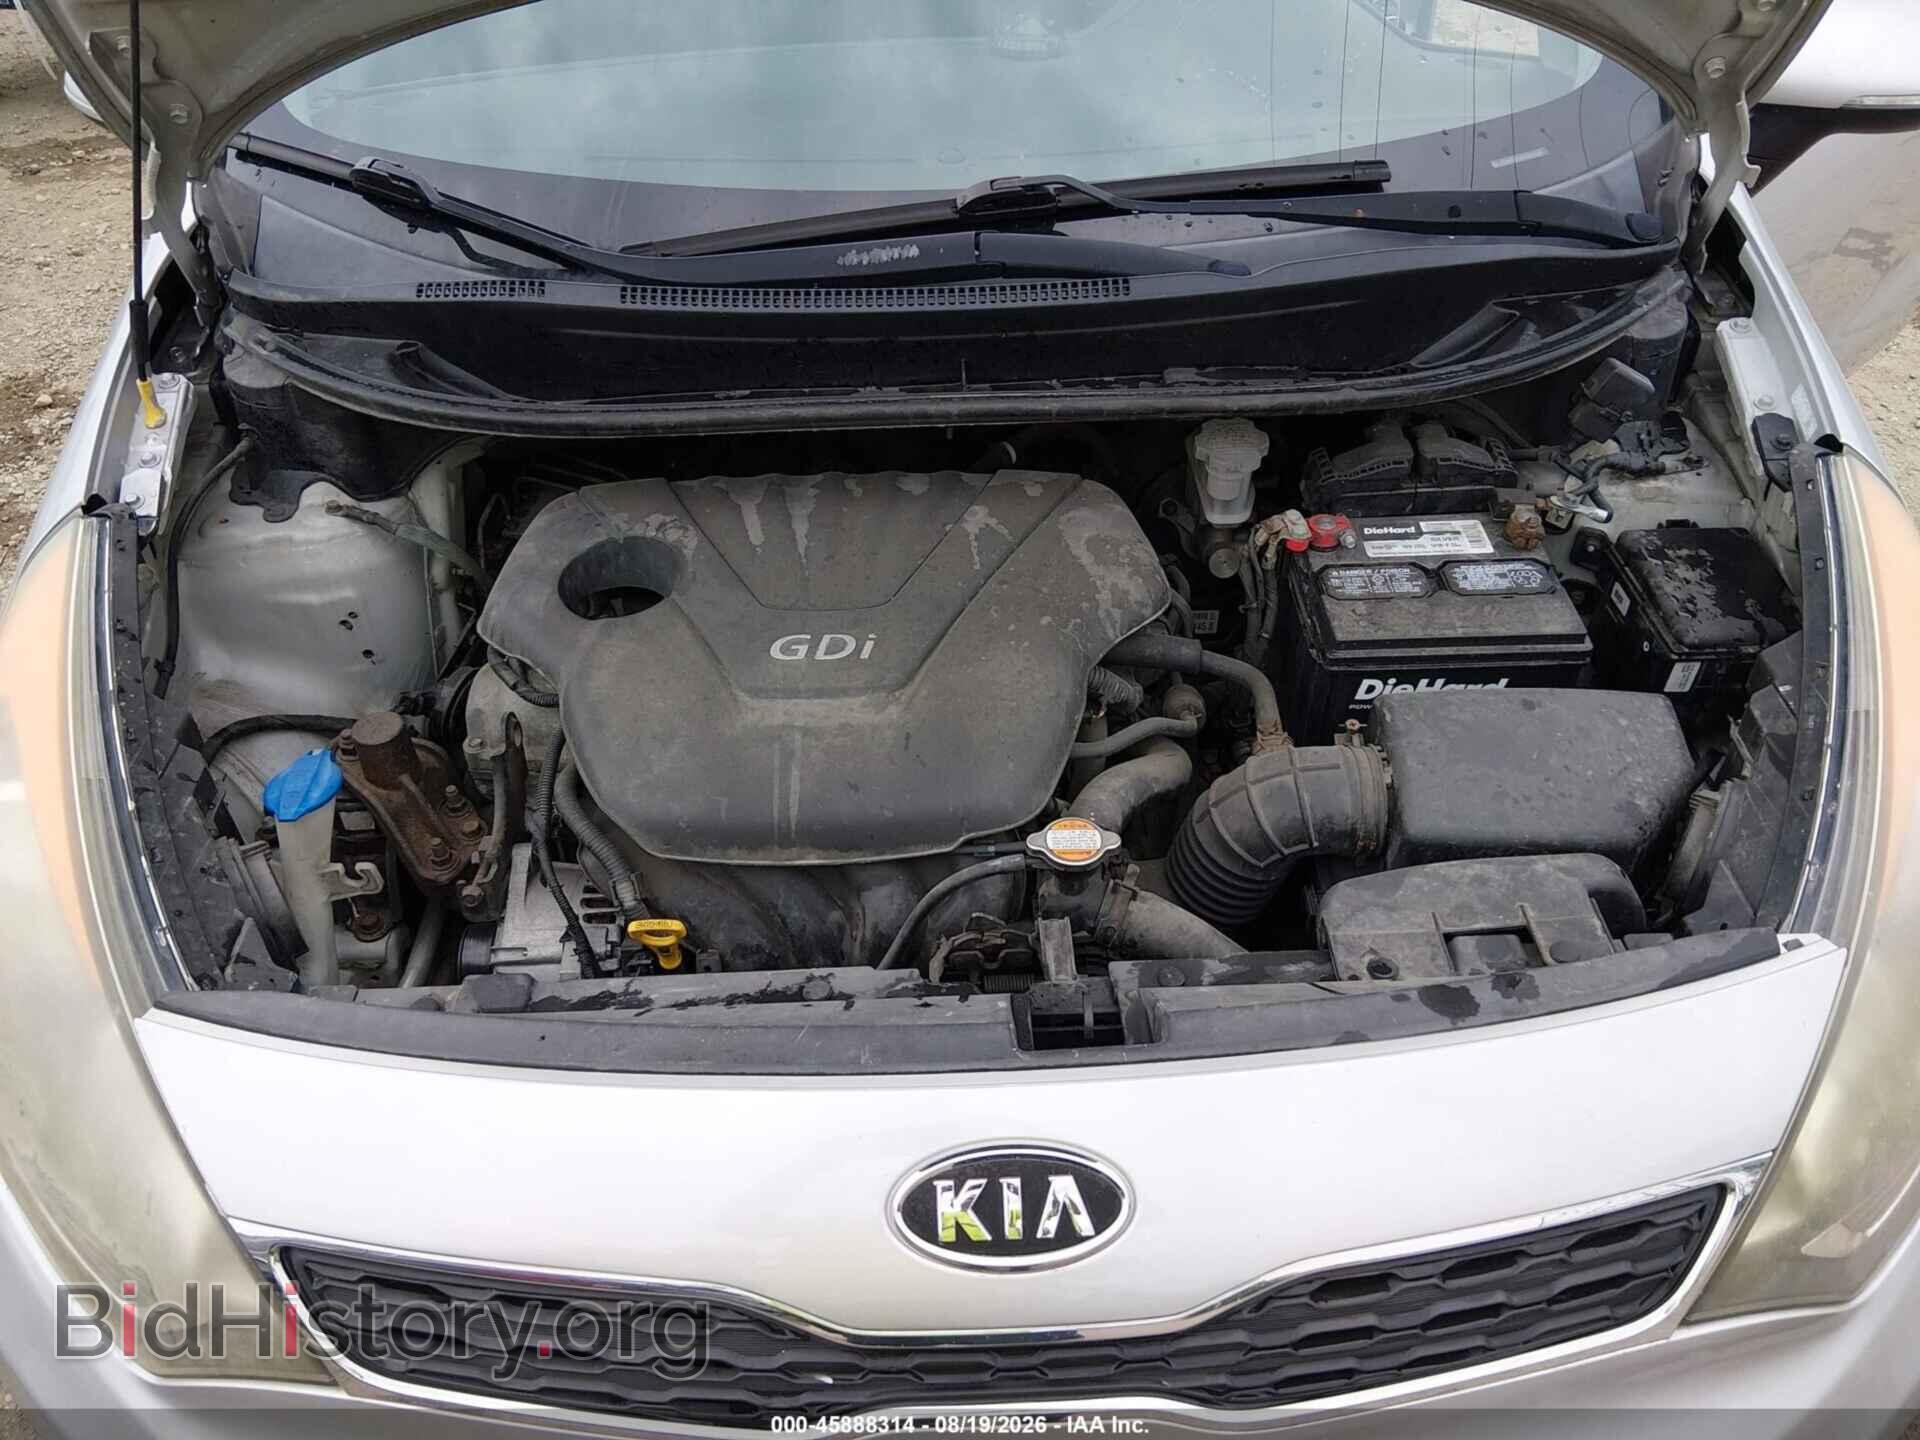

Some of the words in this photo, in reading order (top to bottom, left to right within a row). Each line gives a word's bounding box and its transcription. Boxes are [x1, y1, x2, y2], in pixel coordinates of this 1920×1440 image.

[1363, 526, 1416, 535] DieHard
[769, 633, 878, 660] GDi
[932, 1175, 1096, 1243] KIA
